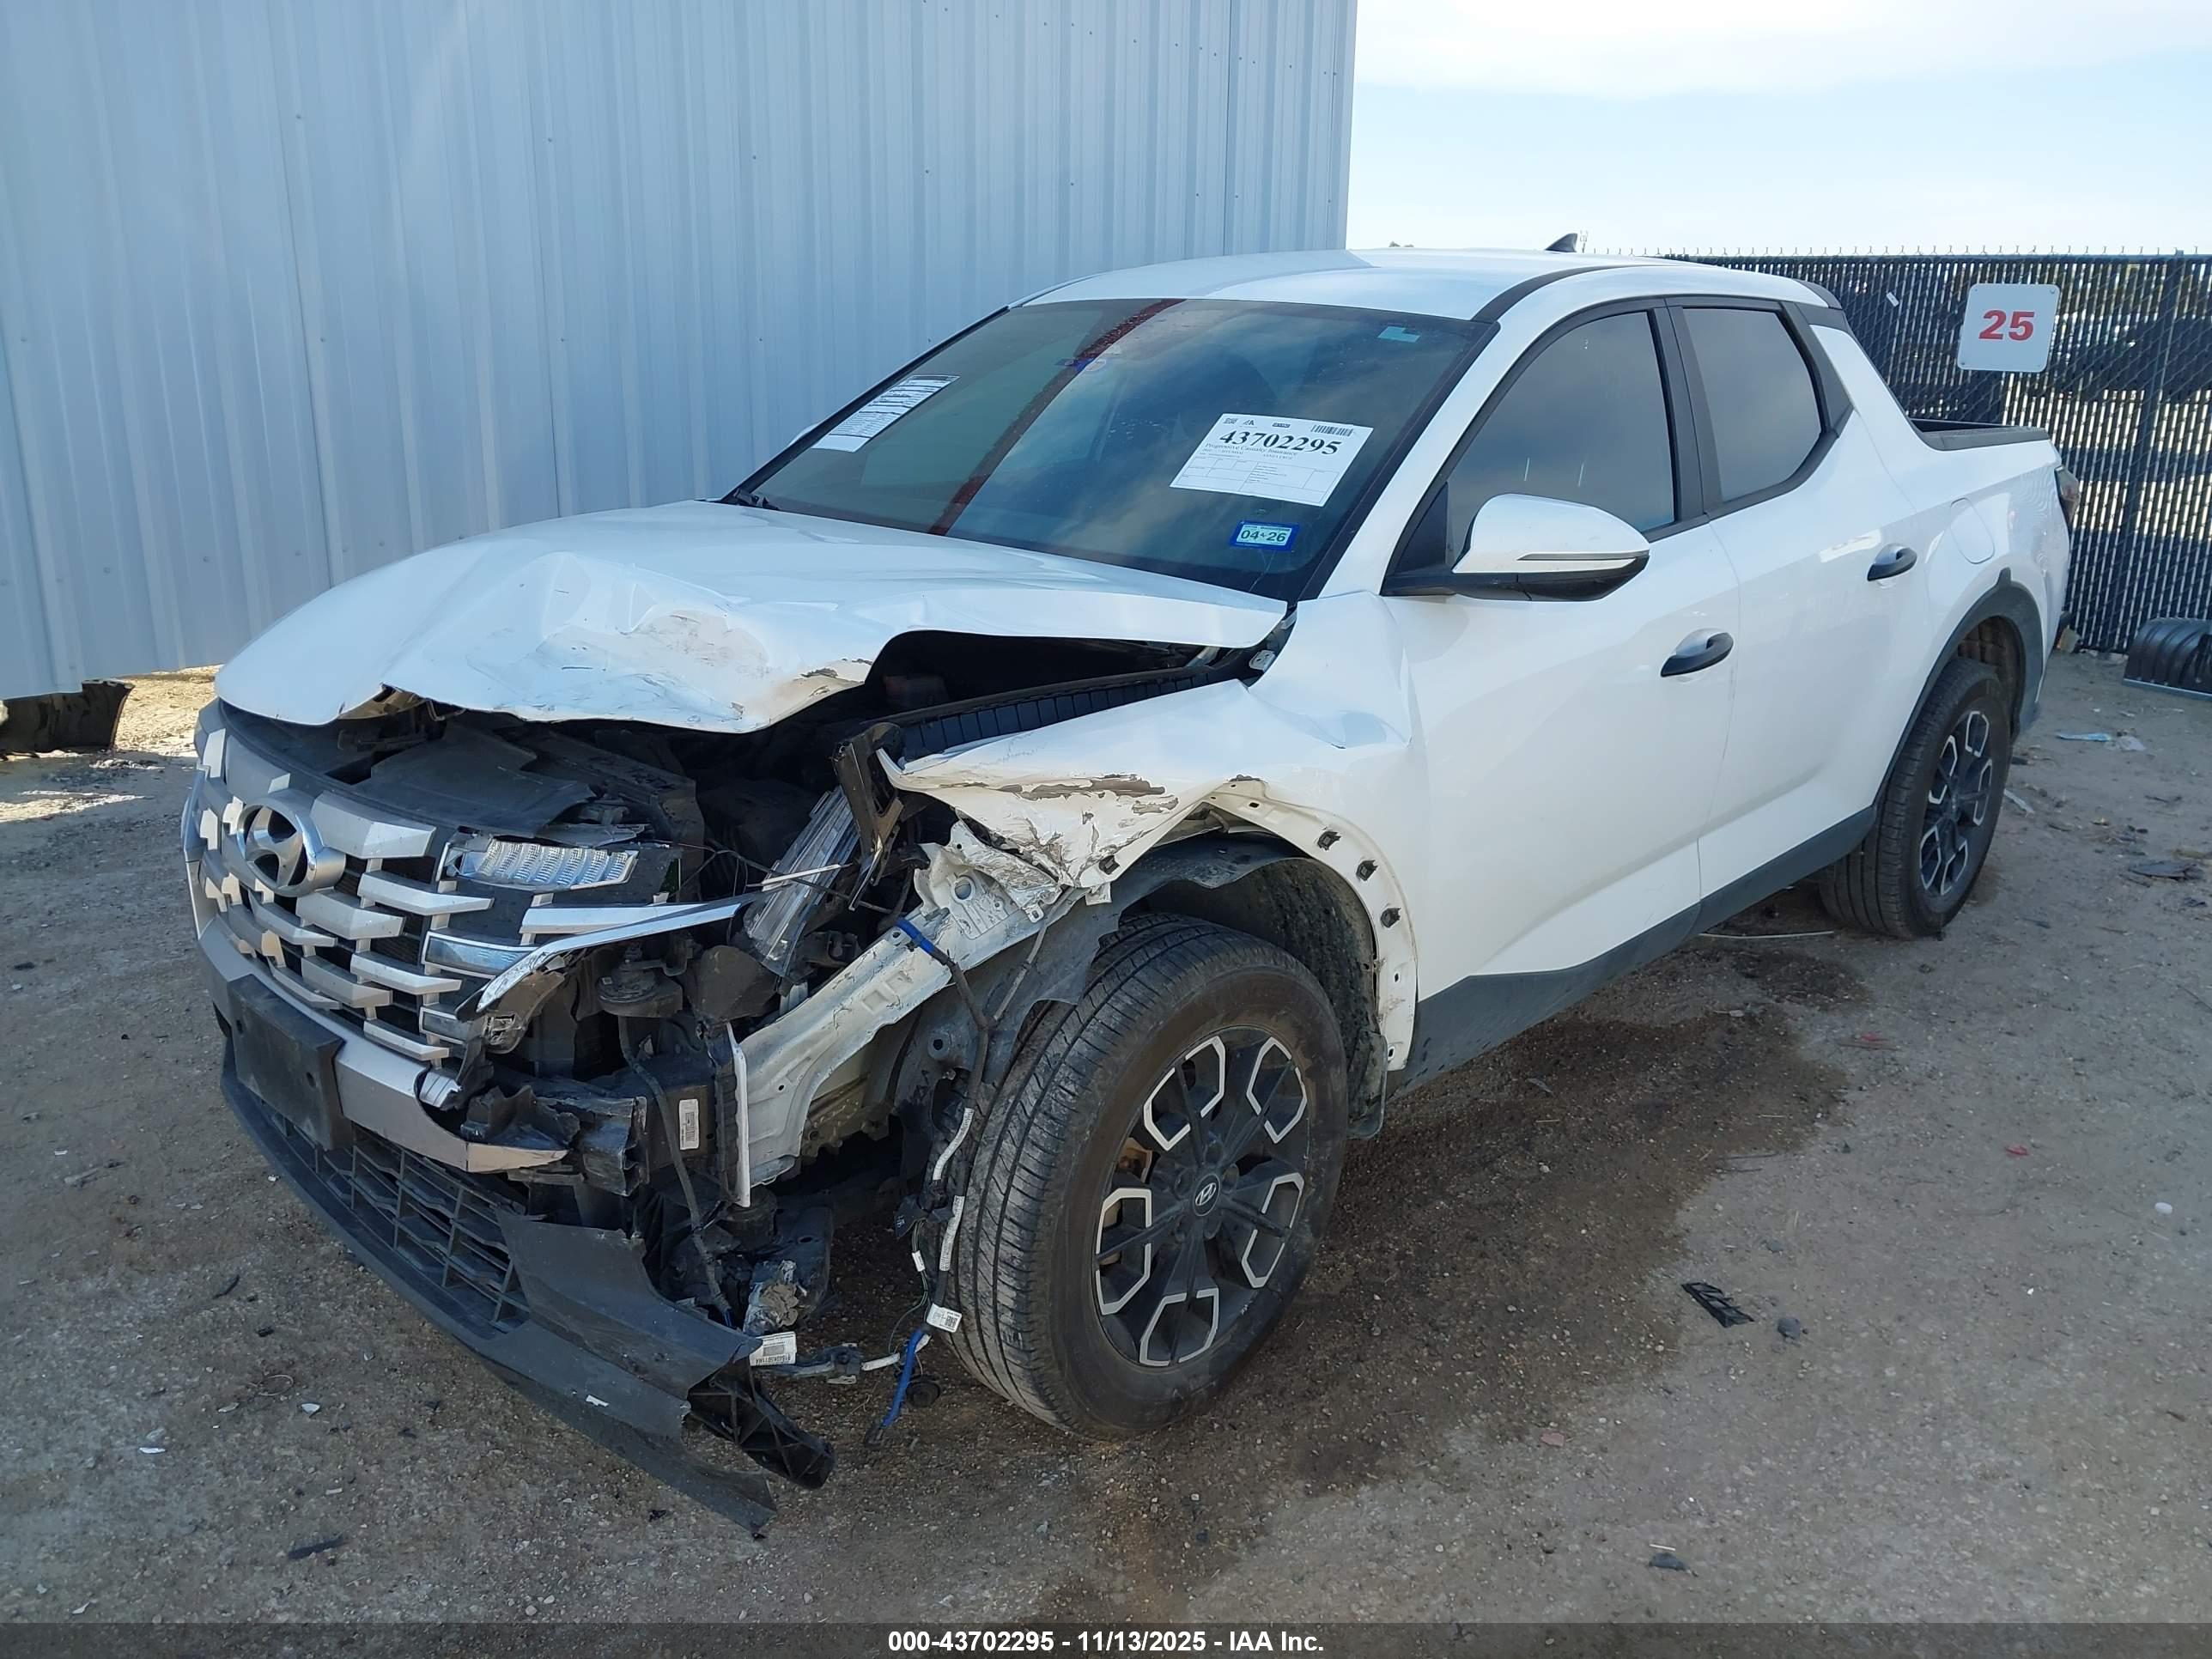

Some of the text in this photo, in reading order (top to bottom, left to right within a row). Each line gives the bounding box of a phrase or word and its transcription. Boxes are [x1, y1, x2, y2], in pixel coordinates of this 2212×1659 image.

[1978, 309, 2035, 341] 25
[1219, 428, 1342, 456] 43702295
[1266, 532, 1287, 542] 26
